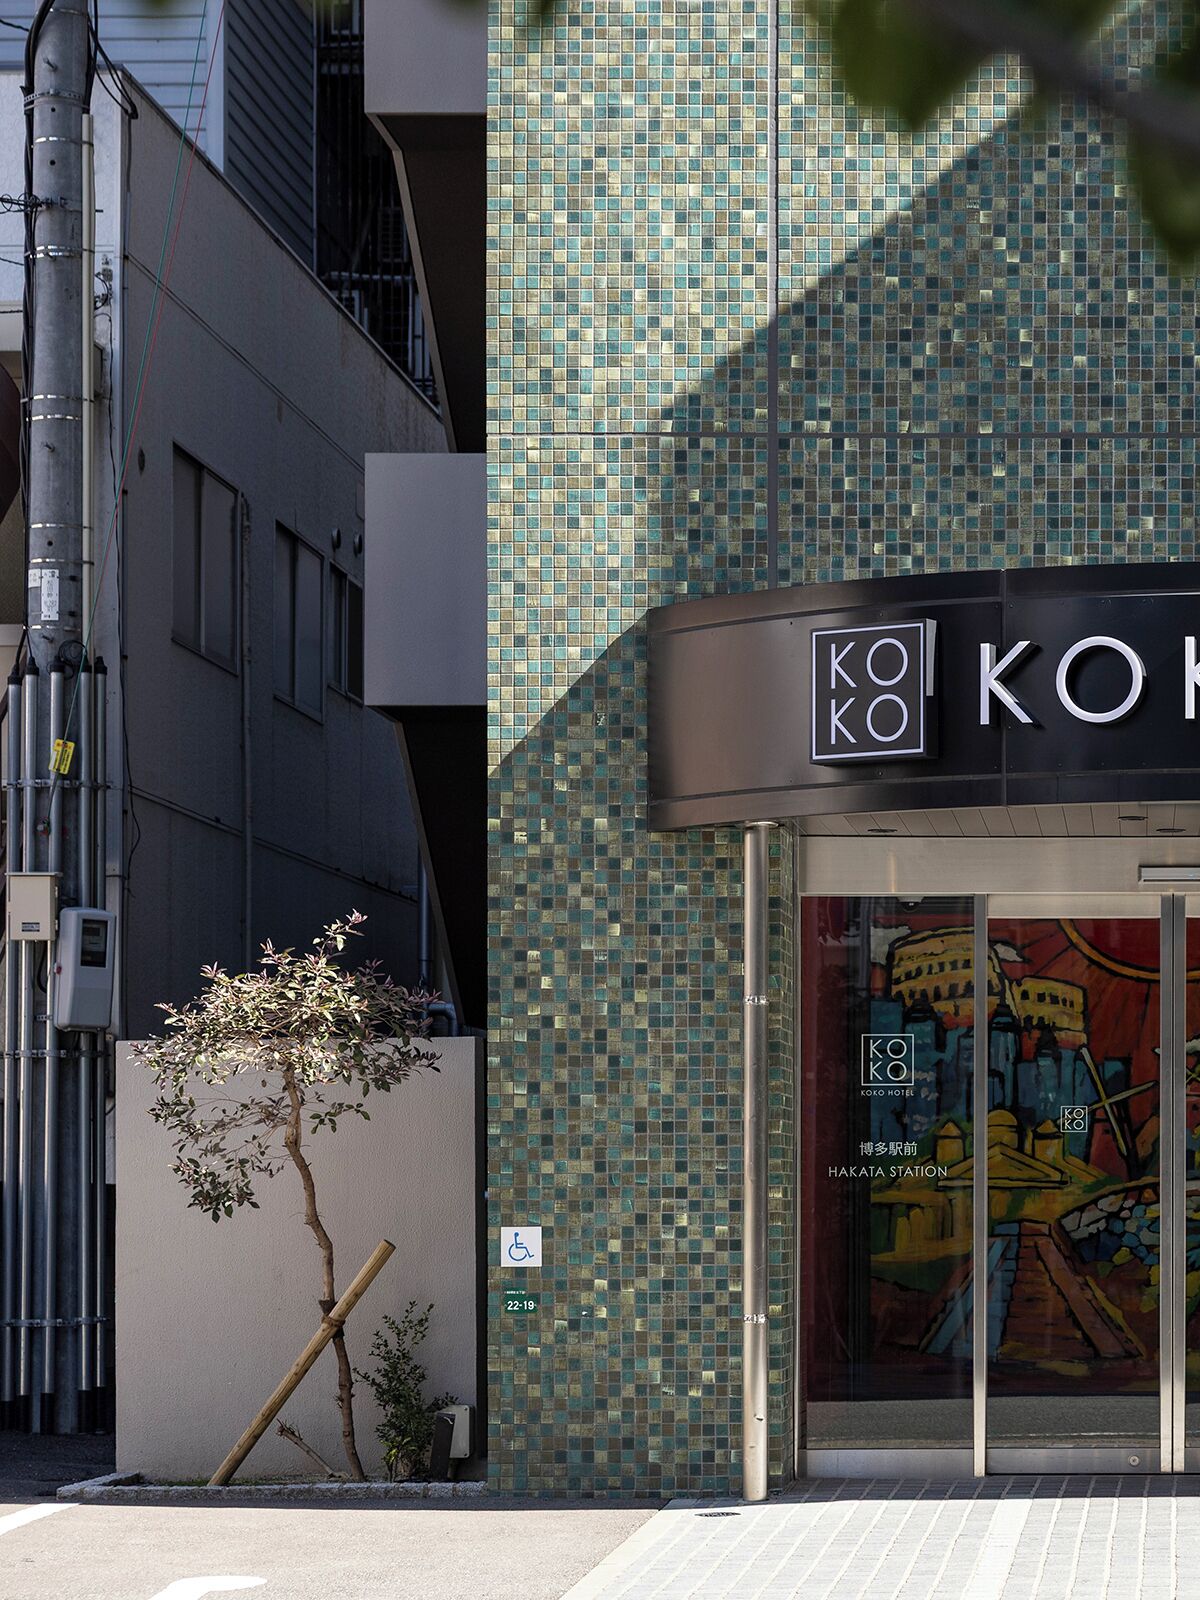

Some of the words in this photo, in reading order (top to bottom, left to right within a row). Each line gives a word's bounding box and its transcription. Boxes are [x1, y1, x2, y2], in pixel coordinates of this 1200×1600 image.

[830, 637, 908, 689] KO
[830, 693, 908, 745] KO
[869, 1038, 907, 1059] KO
[869, 1060, 907, 1081] KO
[860, 1089, 885, 1097] KOKO
[887, 1089, 914, 1097] HOTEL
[1064, 1108, 1085, 1119] KO
[1064, 1119, 1085, 1130] KO
[859, 1141, 918, 1157] 博多駅前
[828, 1165, 886, 1178] HAKATA
[889, 1165, 948, 1178] STATION
[507, 1300, 534, 1310] 22-19
